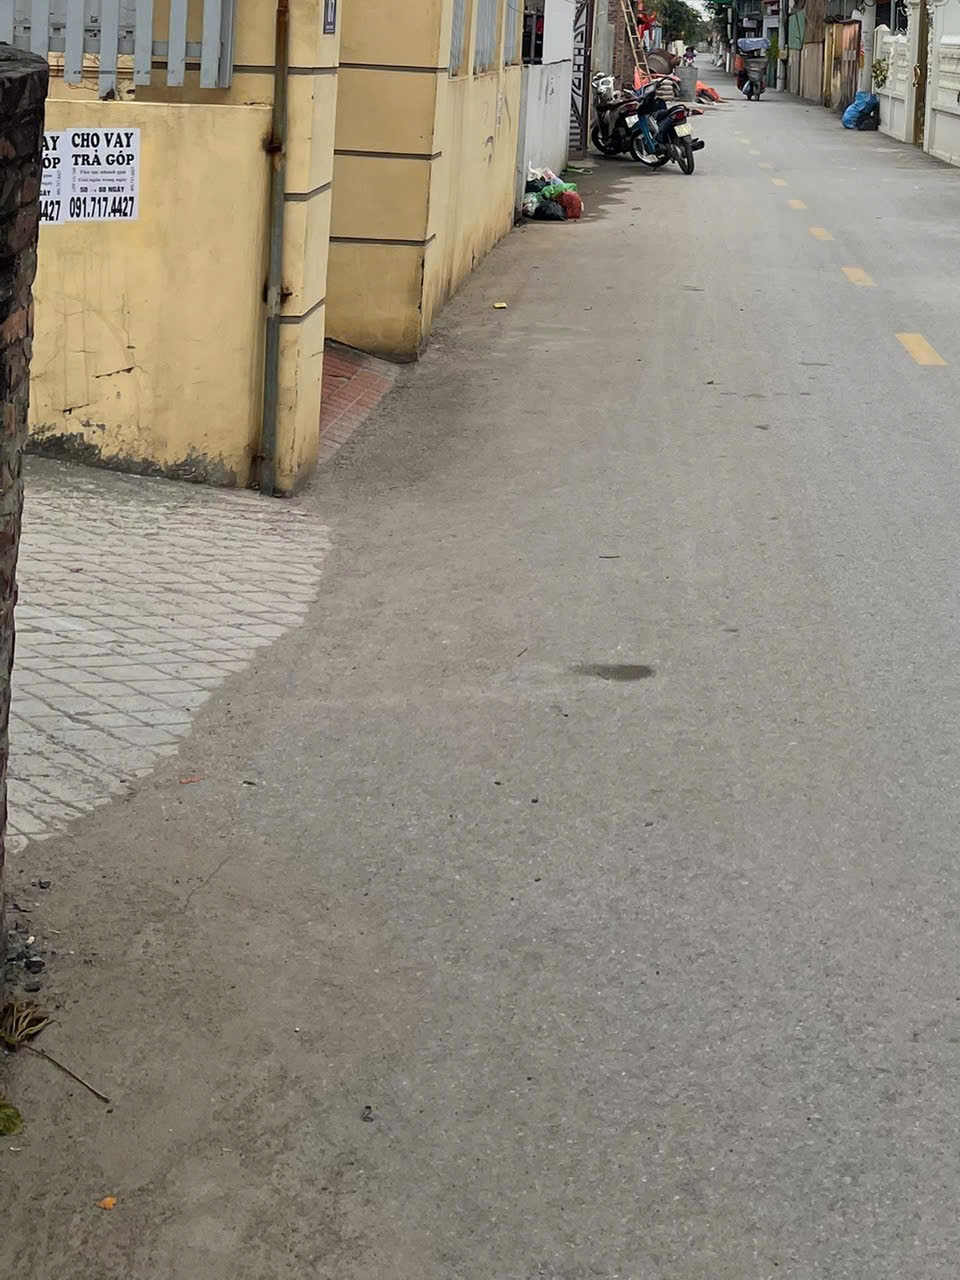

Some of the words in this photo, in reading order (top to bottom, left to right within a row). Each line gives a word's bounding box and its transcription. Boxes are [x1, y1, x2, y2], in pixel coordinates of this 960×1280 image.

[42, 136, 60, 151] AY
[71, 132, 100, 148] CHO
[104, 132, 134, 148] VAY
[42, 153, 61, 169] ÓP
[72, 150, 101, 166] TRẢ
[106, 151, 135, 166] GÓP
[69, 196, 134, 218] 091.717.4427
